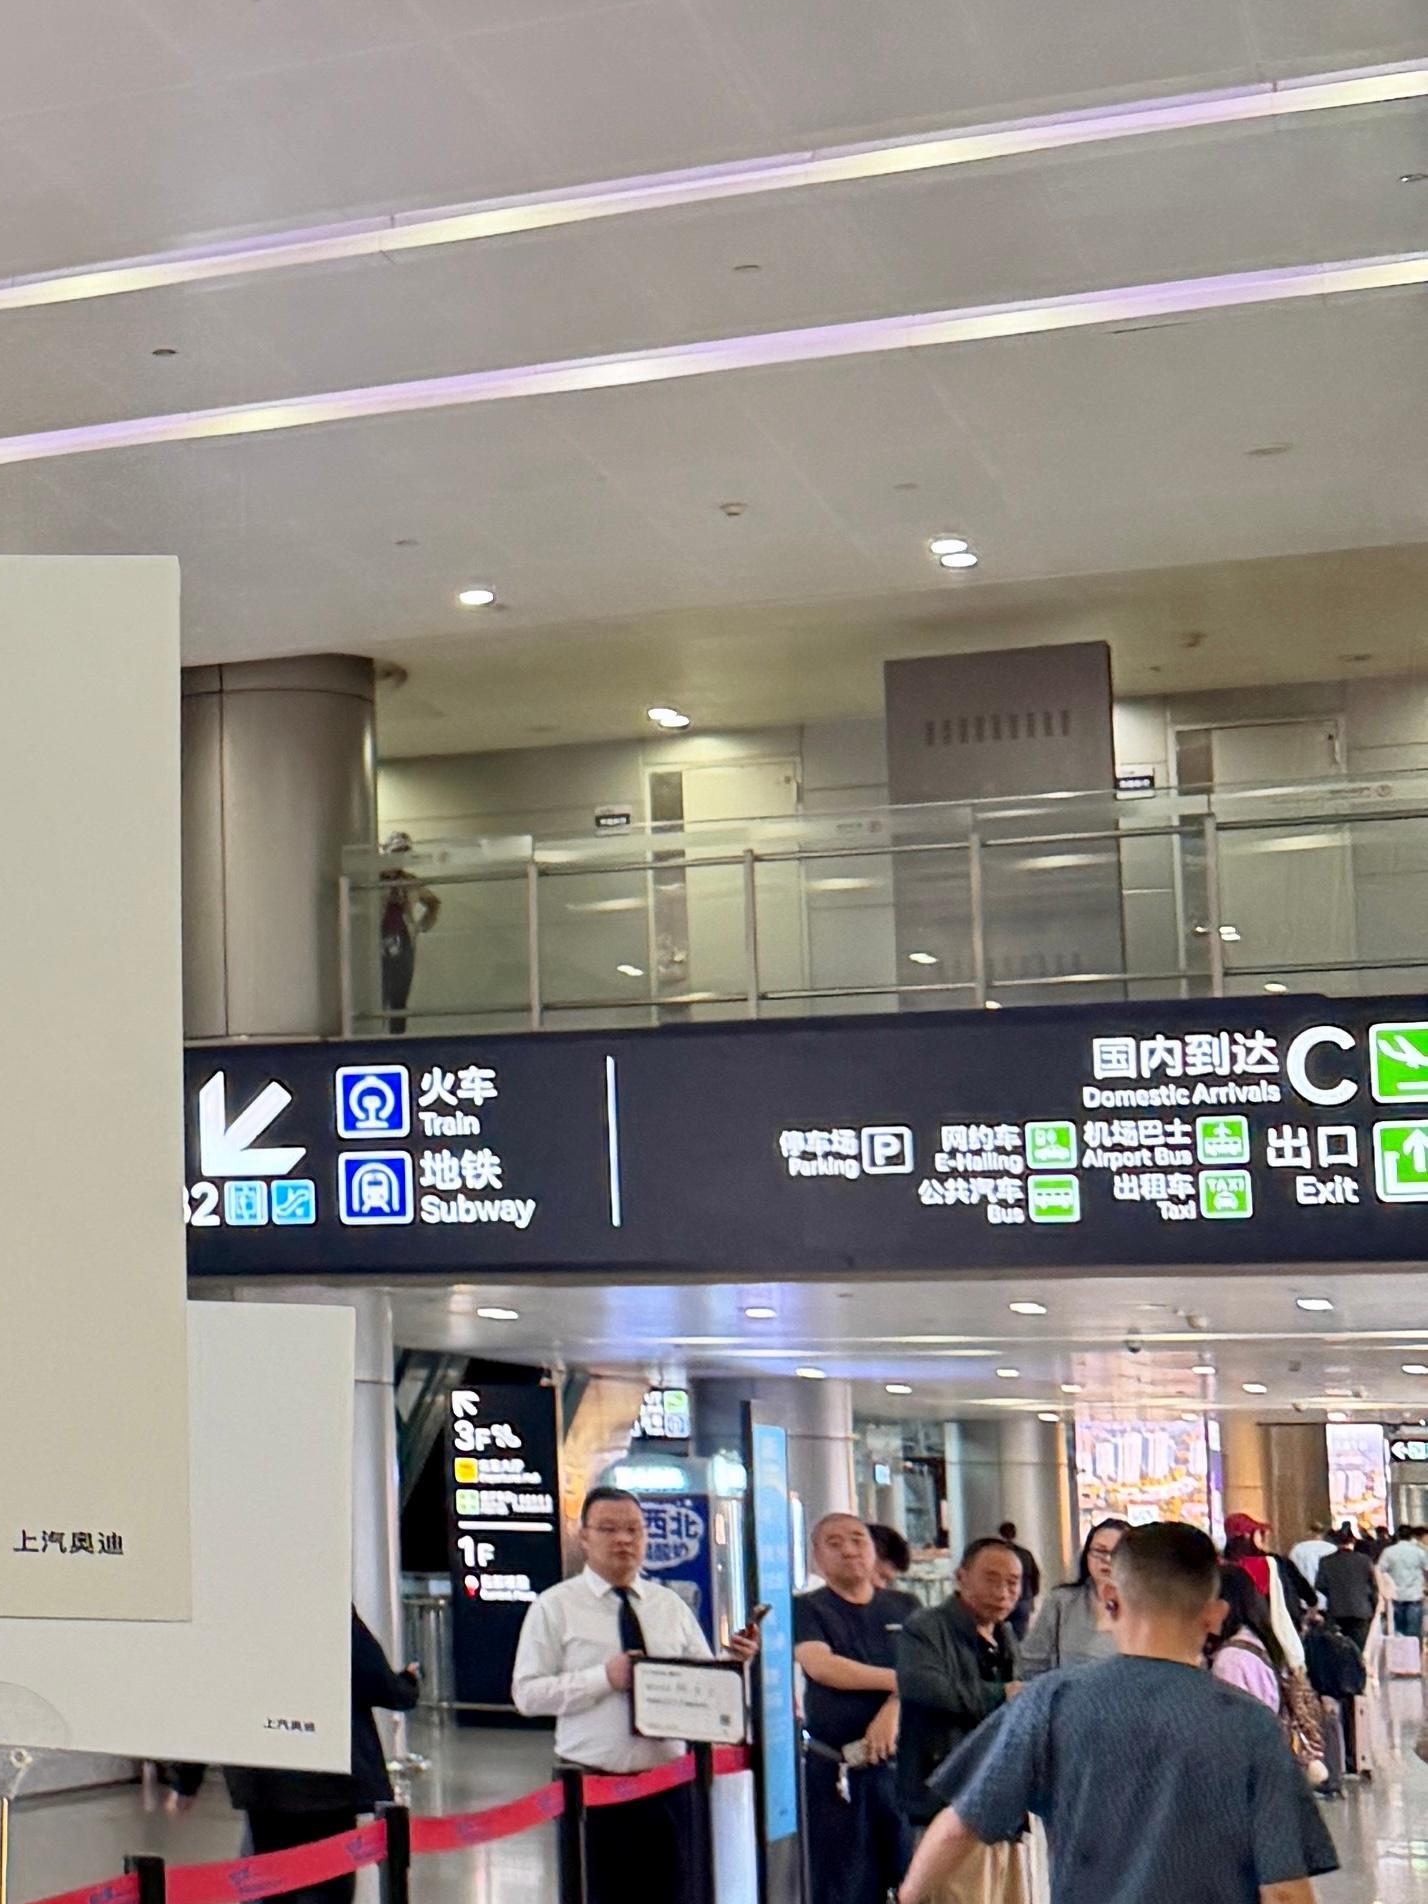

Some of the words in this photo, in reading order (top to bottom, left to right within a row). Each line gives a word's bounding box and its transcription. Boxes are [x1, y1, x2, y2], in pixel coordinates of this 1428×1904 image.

[1093, 1030, 1280, 1079] 国内到达
[1286, 1025, 1358, 1106] C
[418, 1065, 498, 1106] 火车
[1083, 1084, 1190, 1108] Domestic
[1192, 1080, 1281, 1106] Arrivals
[419, 1111, 480, 1136] Train
[941, 1124, 1023, 1152] 网约车
[1083, 1118, 1193, 1147] 机场巴士
[779, 1128, 859, 1158] 停车场
[1267, 1124, 1359, 1169] 出口
[419, 1147, 503, 1190] 地铁
[788, 1156, 860, 1179] Parking
[1083, 1147, 1152, 1171] Airport
[1154, 1147, 1194, 1167] Bus
[918, 1176, 1025, 1205] 公共汽车
[1113, 1172, 1196, 1201] 出租车
[1206, 1178, 1245, 1192] TAXI
[1296, 1174, 1360, 1206] Exit
[420, 1194, 536, 1229] Subway
[987, 1203, 1026, 1224] Bus
[1156, 1200, 1196, 1221] Taxi
[12, 1529, 124, 1555] 上汽奥迪
[457, 1535, 495, 1568] 1F
